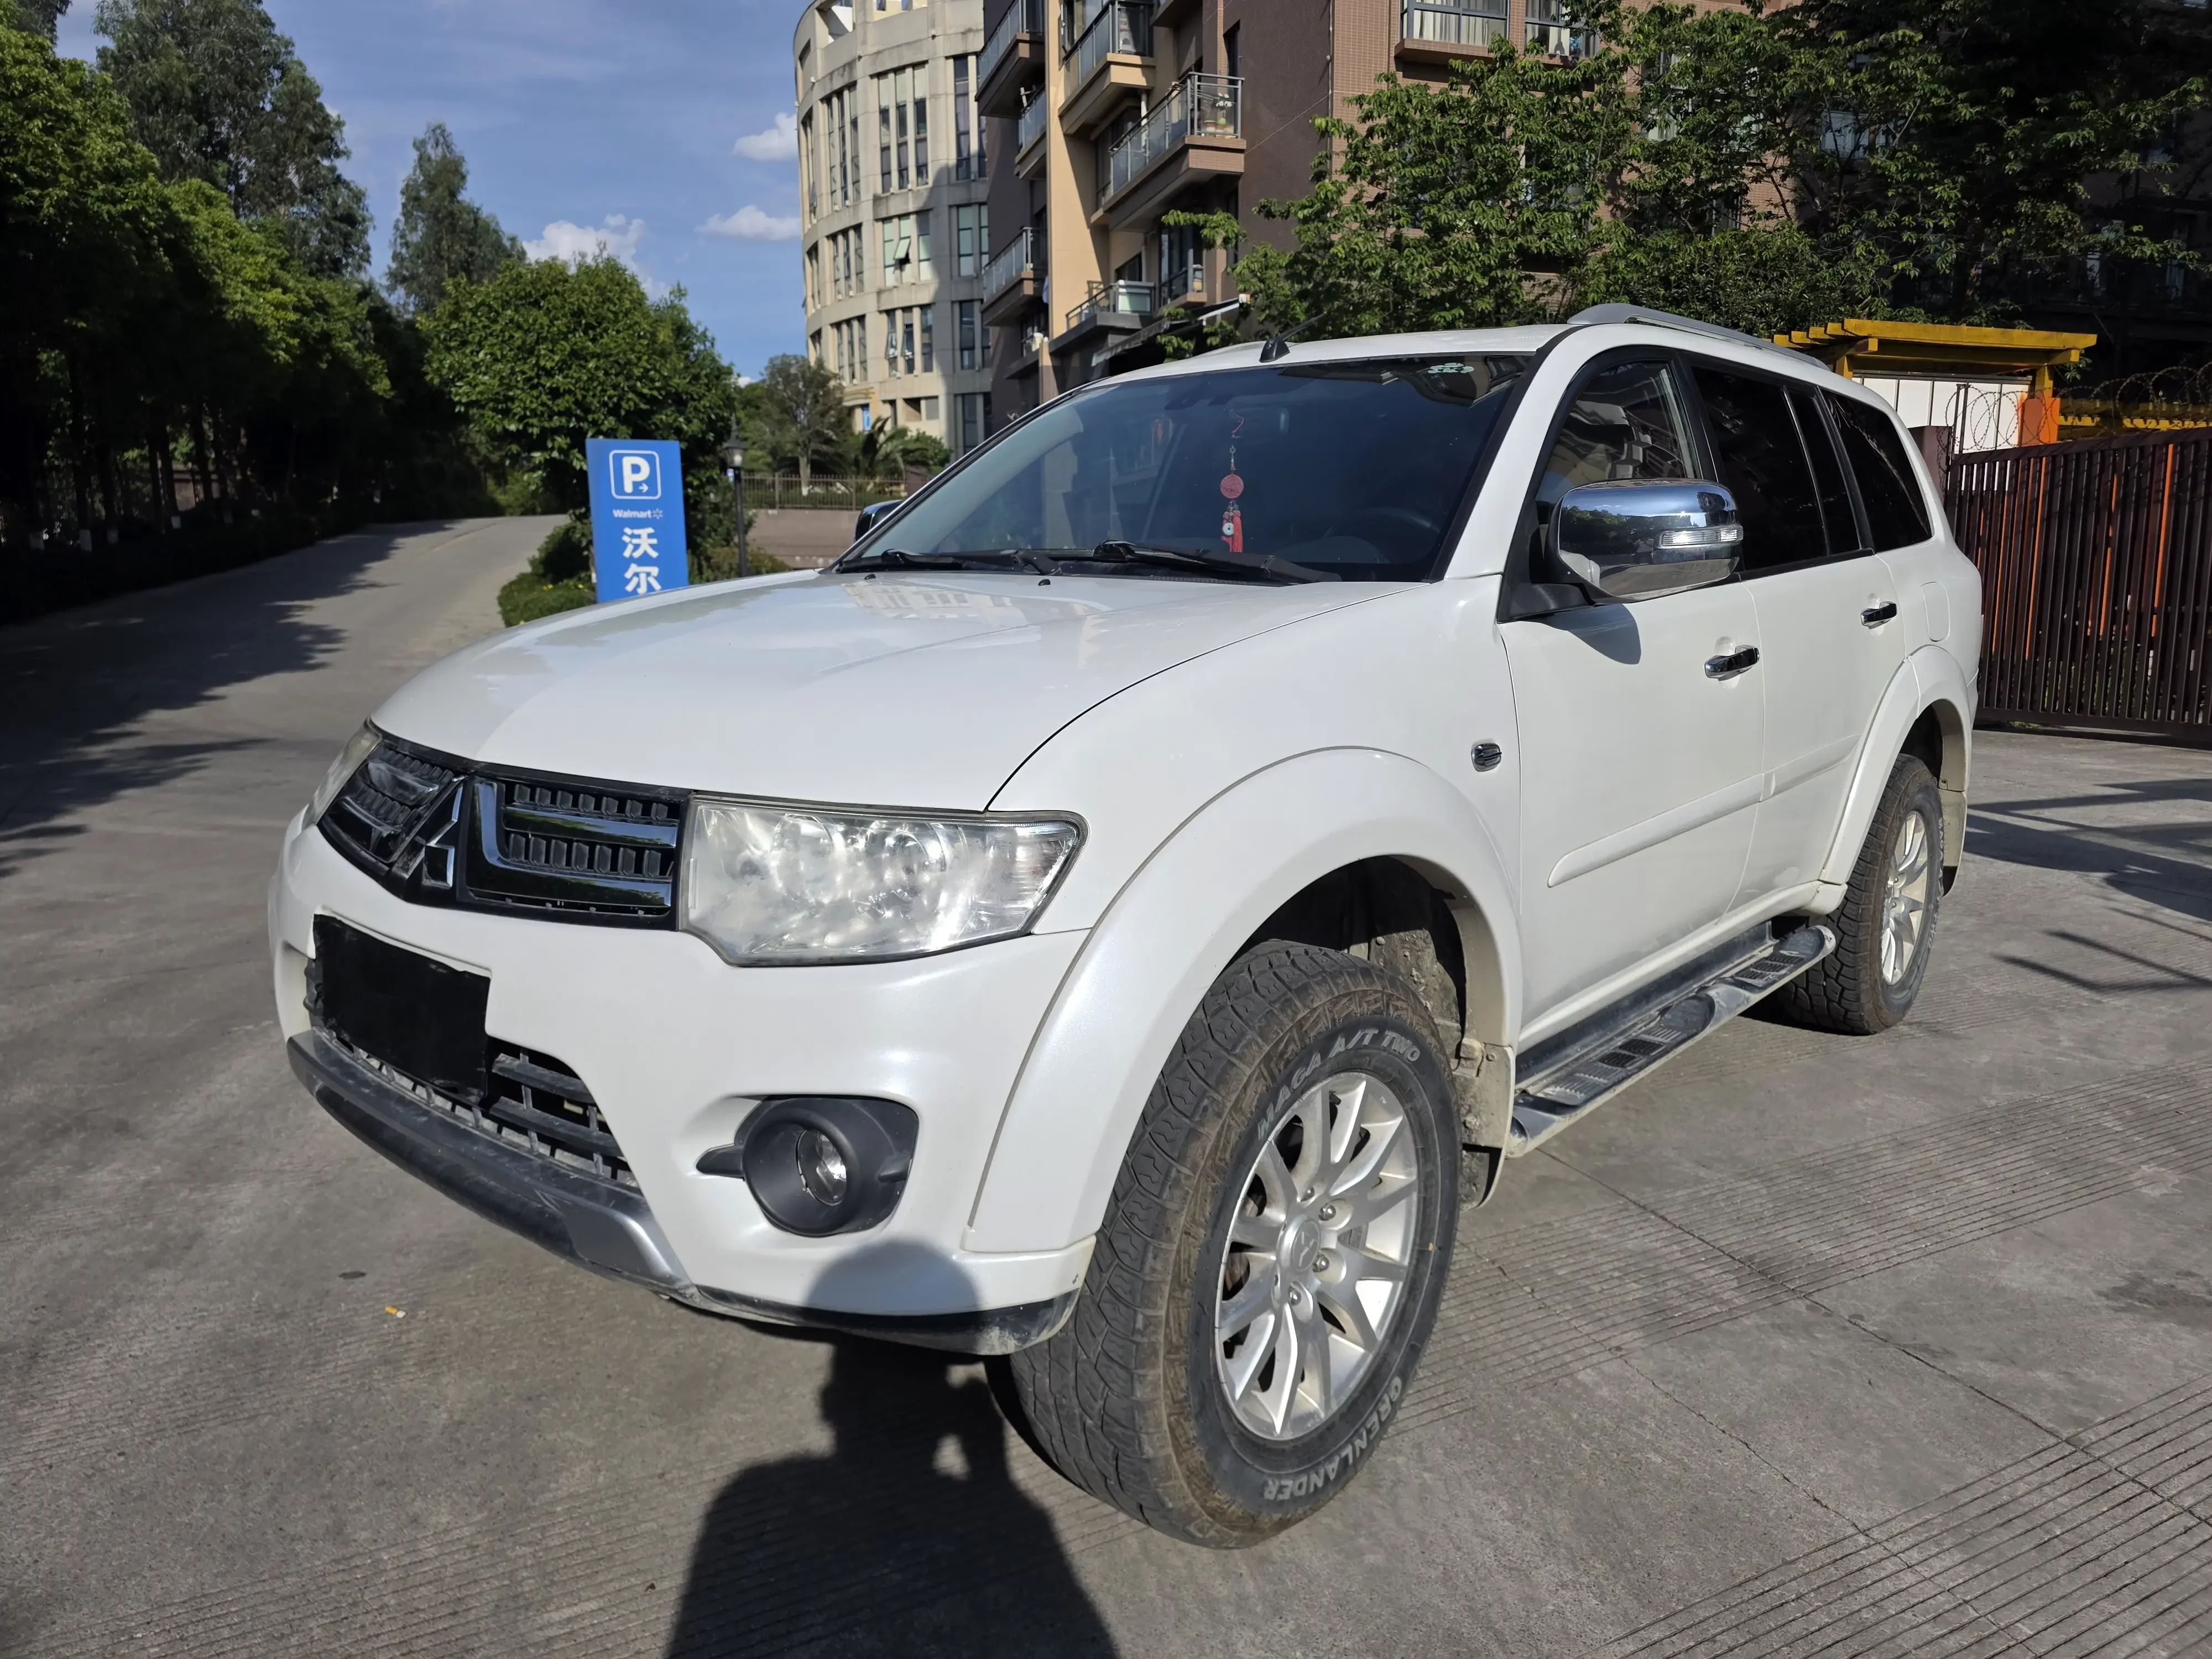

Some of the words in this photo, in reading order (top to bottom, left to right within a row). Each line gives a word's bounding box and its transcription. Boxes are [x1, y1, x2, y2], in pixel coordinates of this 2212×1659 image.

[622, 456, 650, 493] P
[612, 509, 652, 518] Walmart
[622, 527, 662, 595] 沃尔
[1328, 1028, 1379, 1059] A/T
[1381, 1030, 1421, 1062] TWO
[1263, 1376, 1402, 1500] GRENLANDER
